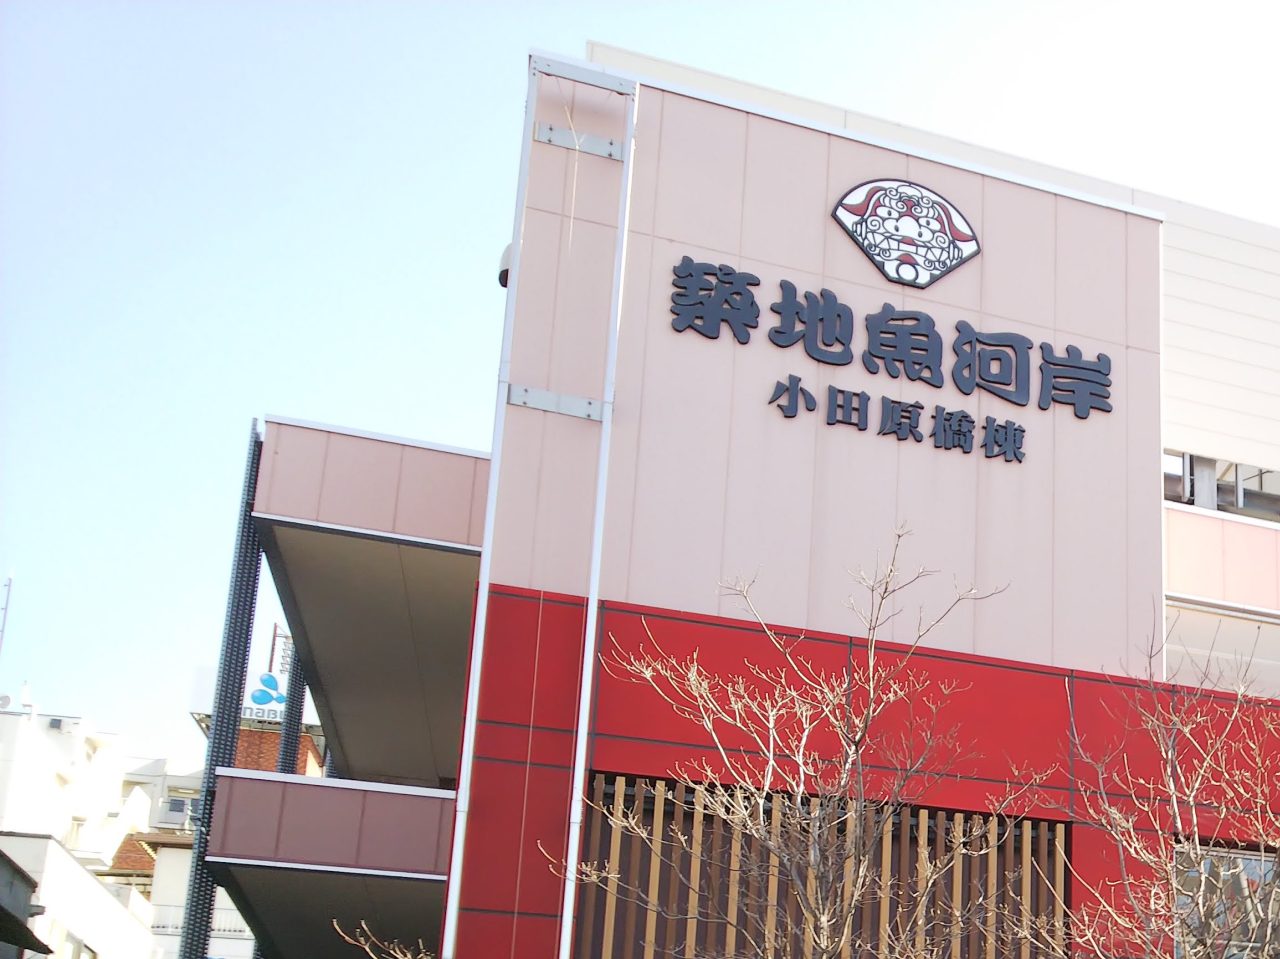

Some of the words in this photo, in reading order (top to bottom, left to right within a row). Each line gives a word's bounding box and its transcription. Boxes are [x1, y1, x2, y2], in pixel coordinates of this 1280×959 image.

[670, 256, 1113, 419] 築地魚河岸
[768, 374, 1026, 463] 小田原橋棟
